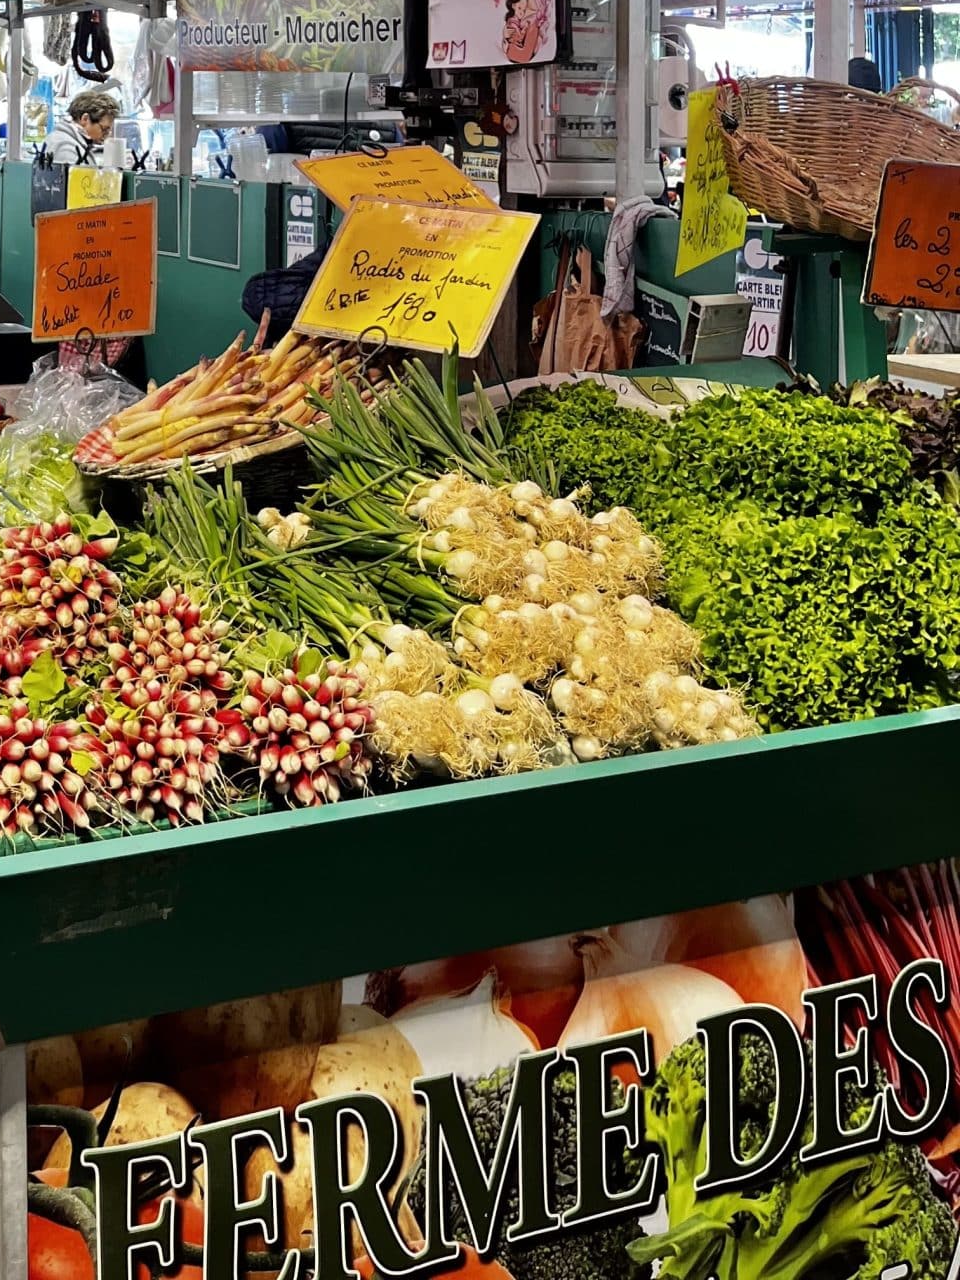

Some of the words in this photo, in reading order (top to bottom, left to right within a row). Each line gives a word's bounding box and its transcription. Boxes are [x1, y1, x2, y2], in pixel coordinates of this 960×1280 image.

[180, 16, 268, 48] Producteur
[286, 11, 402, 45] Maraîcher
[76, 222, 85, 231] CE
[85, 219, 107, 230] MATIN
[419, 217, 433, 225] CE
[434, 218, 464, 229] MATIN
[86, 236, 95, 245] EN
[425, 233, 438, 242] EN
[894, 218, 918, 250] les
[927, 226, 950, 255] 2
[73, 250, 112, 261] PROMOTION
[398, 246, 458, 261] PROMOTION
[350, 249, 406, 281] Radis
[56, 262, 119, 292] Salade
[411, 269, 432, 283] du
[737, 281, 763, 294] CARTE
[80, 1028, 660, 1280] FERME
[694, 958, 950, 1191] DES
